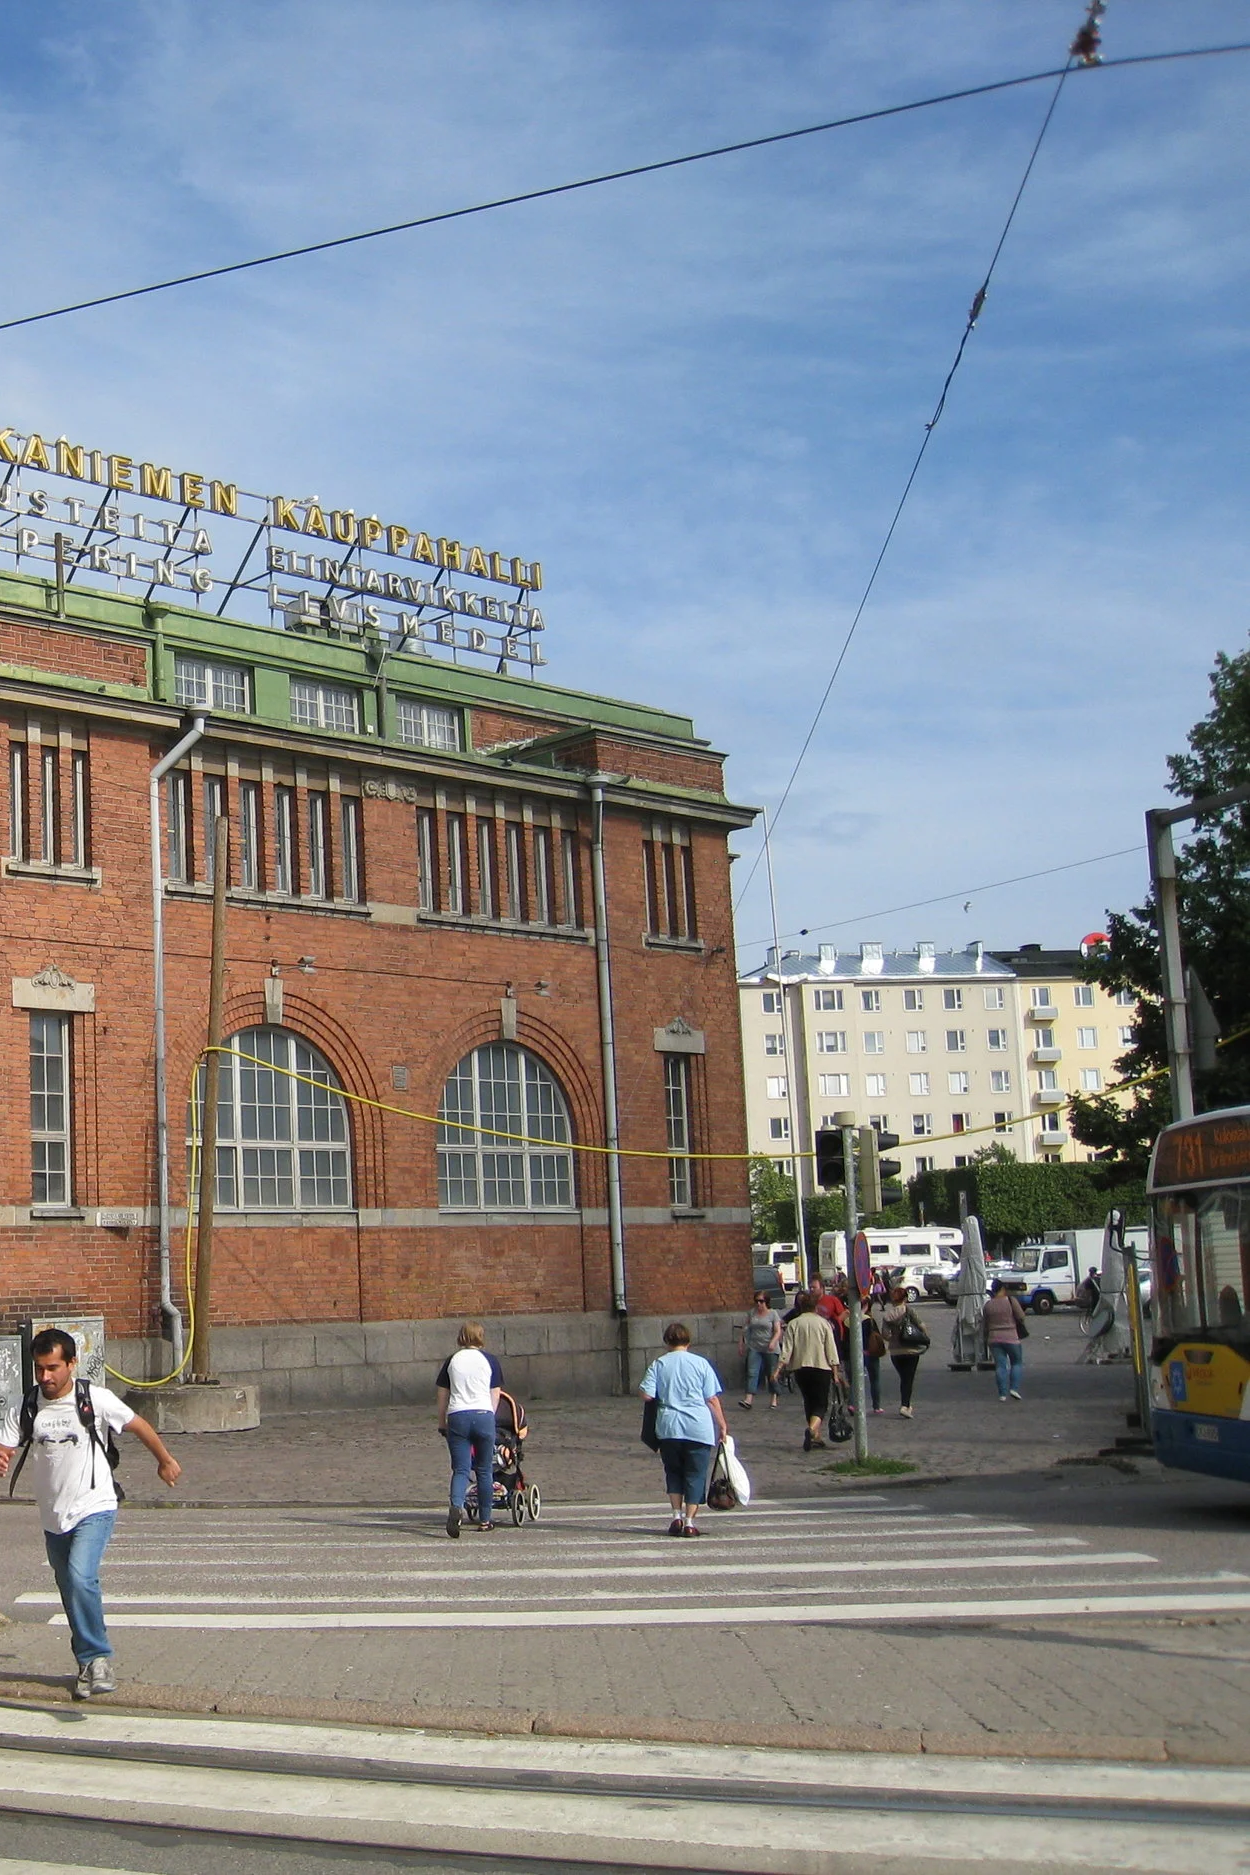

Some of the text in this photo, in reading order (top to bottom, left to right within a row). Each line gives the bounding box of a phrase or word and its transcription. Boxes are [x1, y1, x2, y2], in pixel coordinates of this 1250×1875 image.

[272, 495, 543, 591] KAUPPAHALLI
[266, 545, 546, 632] ELINTARVIKKEITA
[267, 583, 548, 666] LIVSMEDEL
[1173, 1131, 1204, 1178] 731
